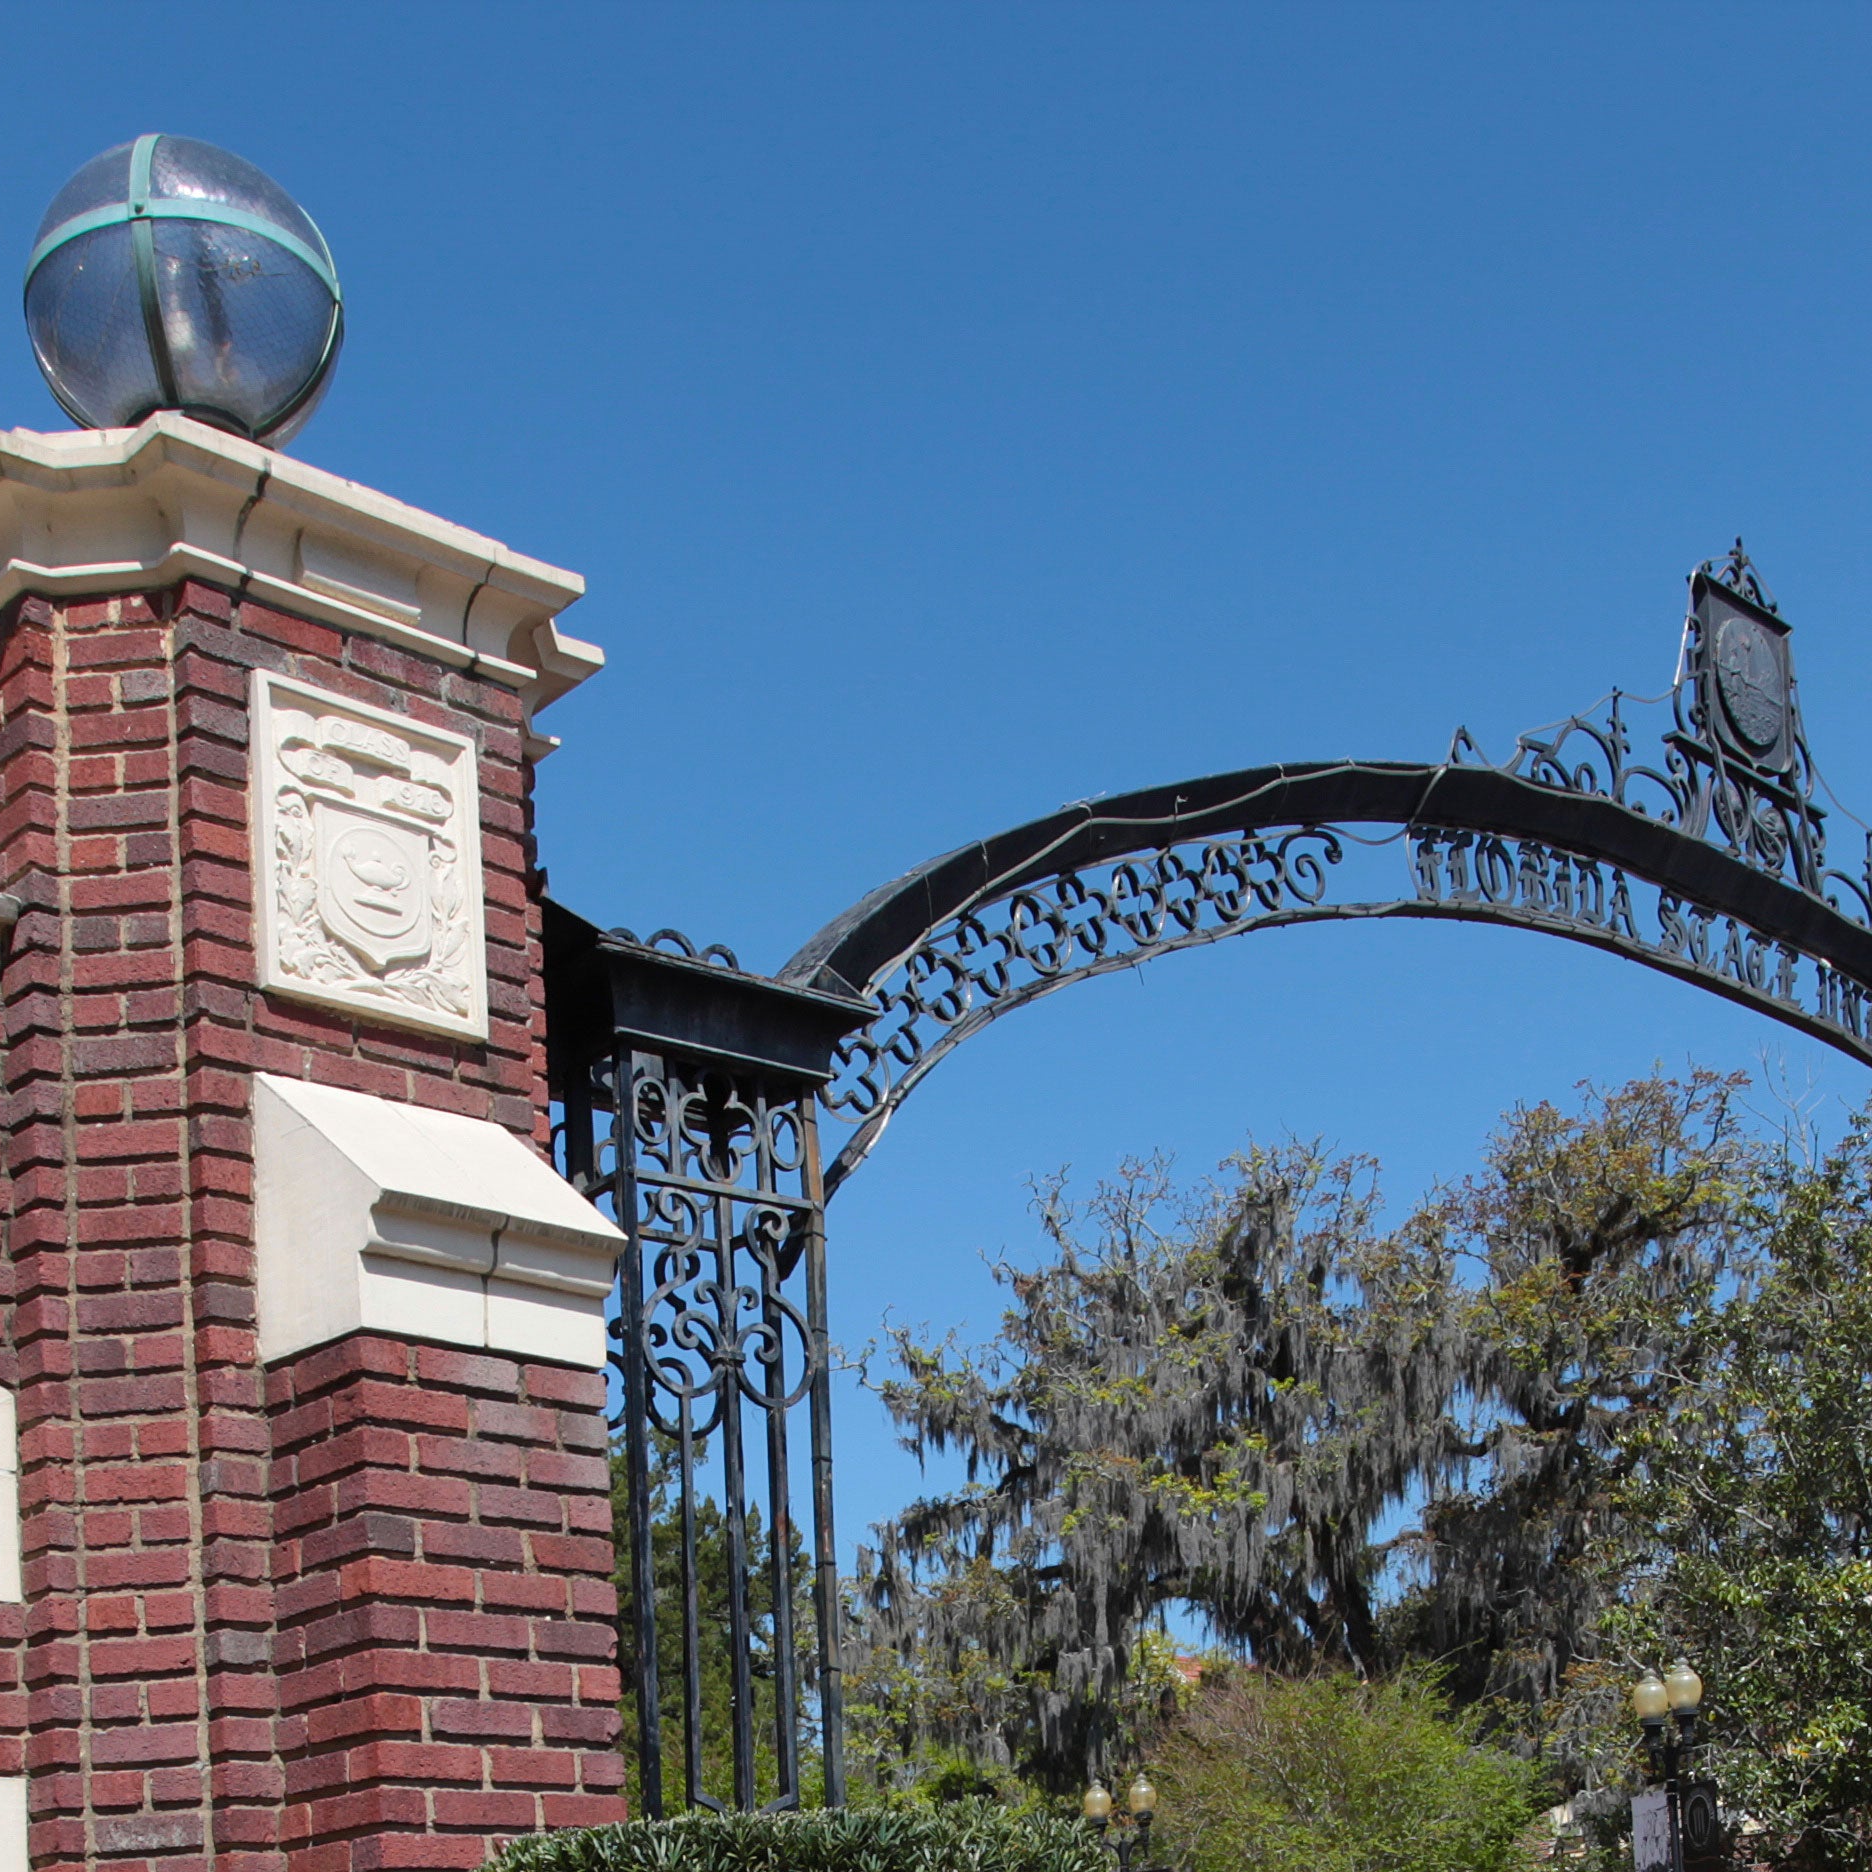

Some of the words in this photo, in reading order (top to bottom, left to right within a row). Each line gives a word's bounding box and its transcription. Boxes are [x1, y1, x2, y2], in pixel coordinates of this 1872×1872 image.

[332, 722, 409, 763] CLASS
[309, 755, 341, 779] OF
[1409, 826, 1641, 944] FLORIDA
[1658, 888, 1802, 1009] STATE
